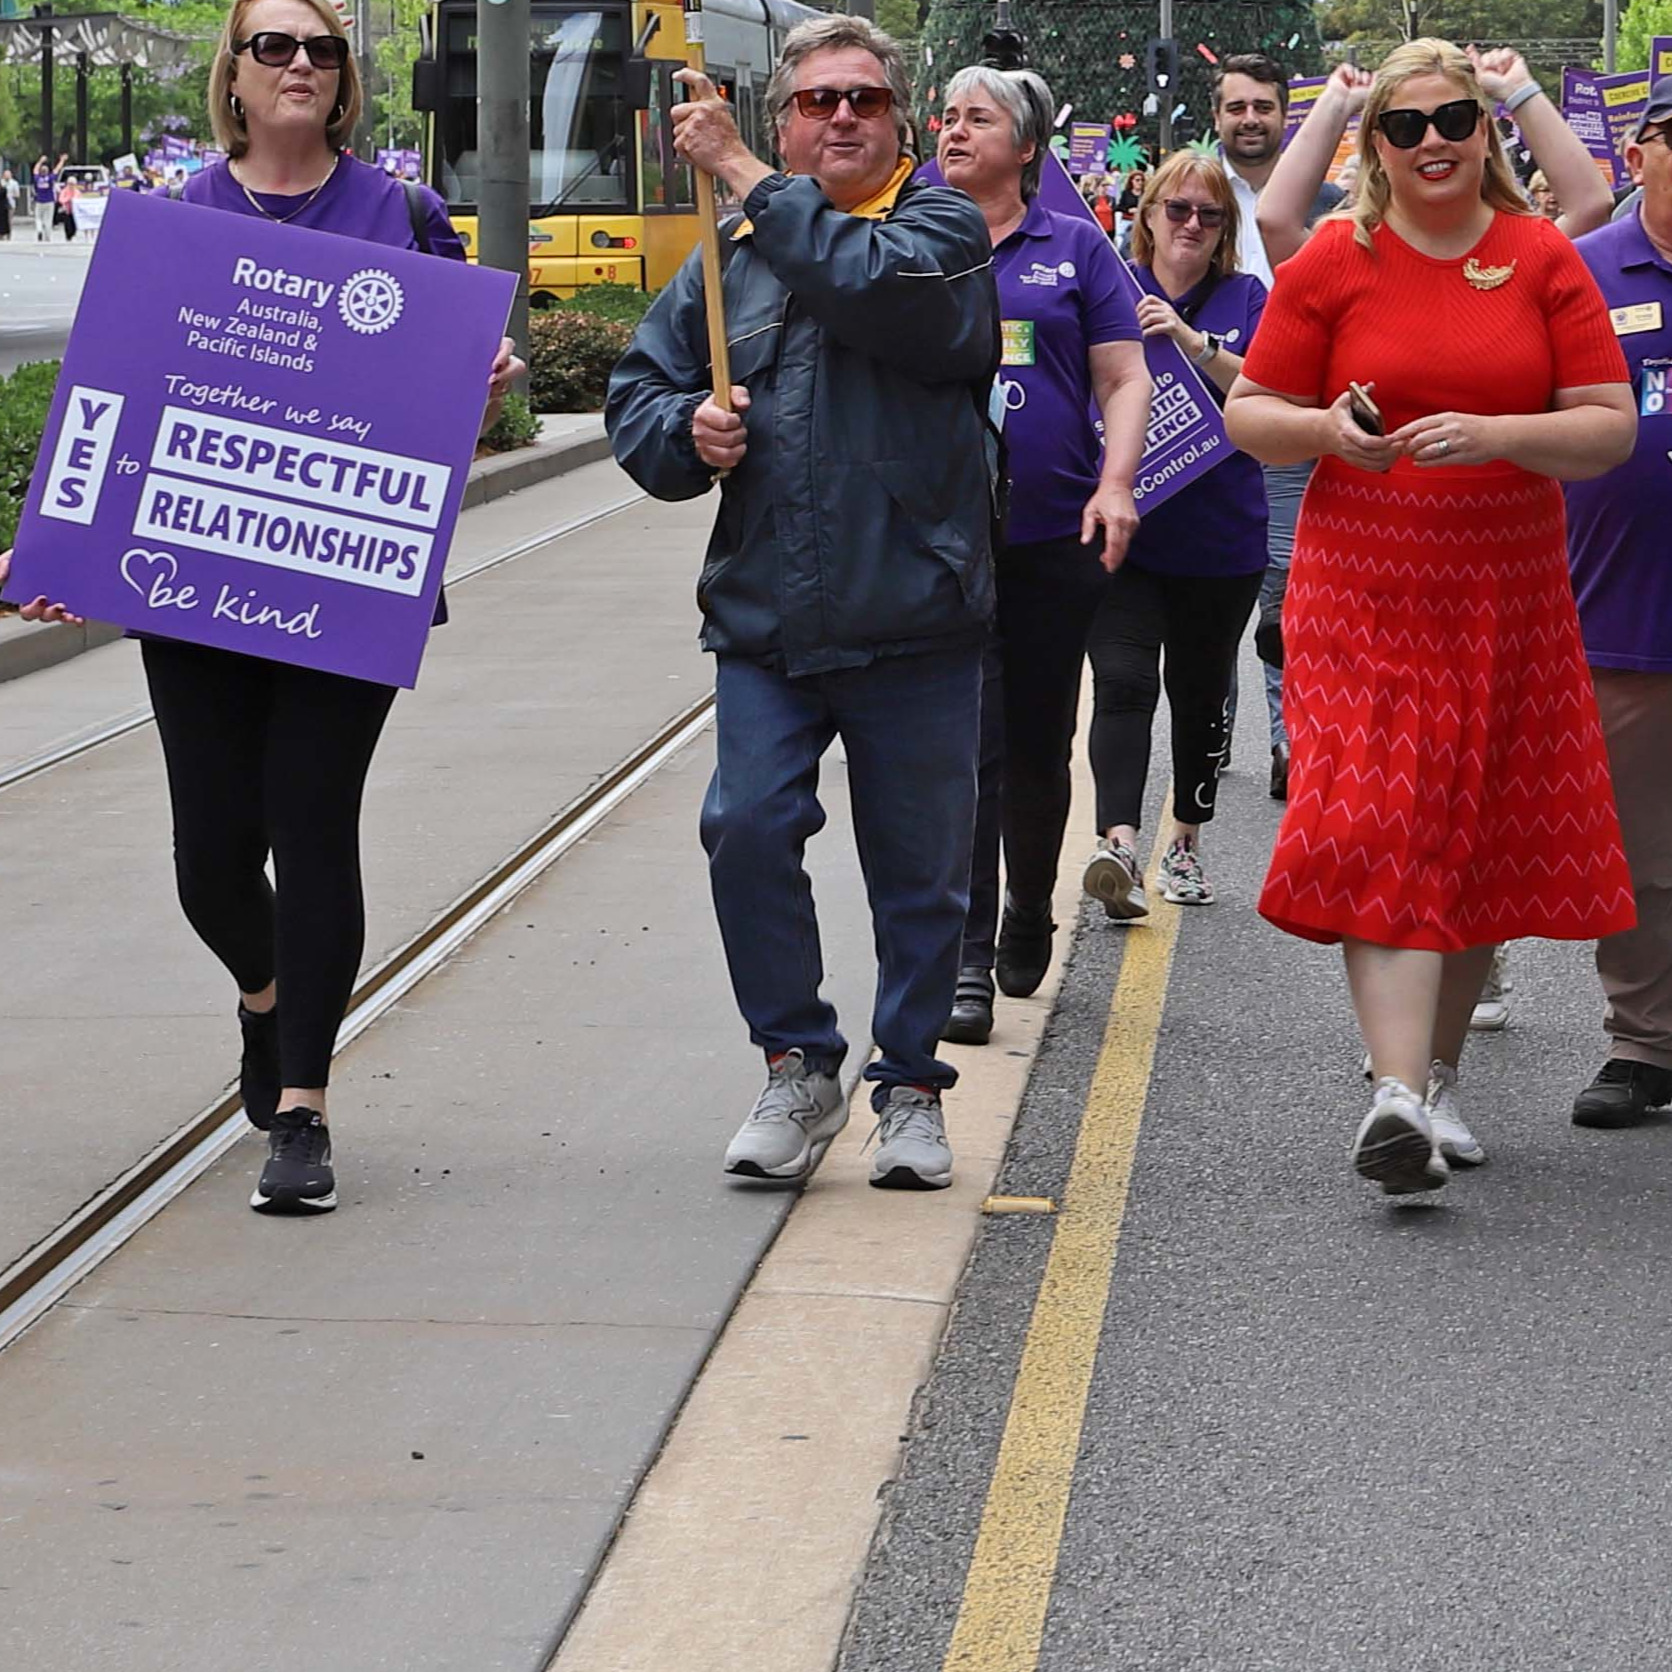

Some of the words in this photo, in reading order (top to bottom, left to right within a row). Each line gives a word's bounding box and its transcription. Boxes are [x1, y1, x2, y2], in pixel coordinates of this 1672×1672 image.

[233, 257, 334, 308] Rotary
[178, 306, 221, 332] New
[224, 316, 298, 347] Zealand
[303, 333, 318, 352] &
[237, 297, 324, 333] Australia,
[186, 330, 245, 359] Pacific
[249, 343, 316, 374] Islands
[1156, 372, 1173, 388] to
[1646, 371, 1665, 412] NO
[163, 375, 277, 416] Together
[284, 404, 322, 425] we
[331, 414, 373, 441] say
[55, 397, 111, 510] YES
[114, 453, 140, 476] to
[166, 421, 432, 514] RESPECTFUL
[148, 490, 420, 581] RELATIONSHIPS
[148, 572, 198, 611] be
[212, 584, 322, 639] kind
